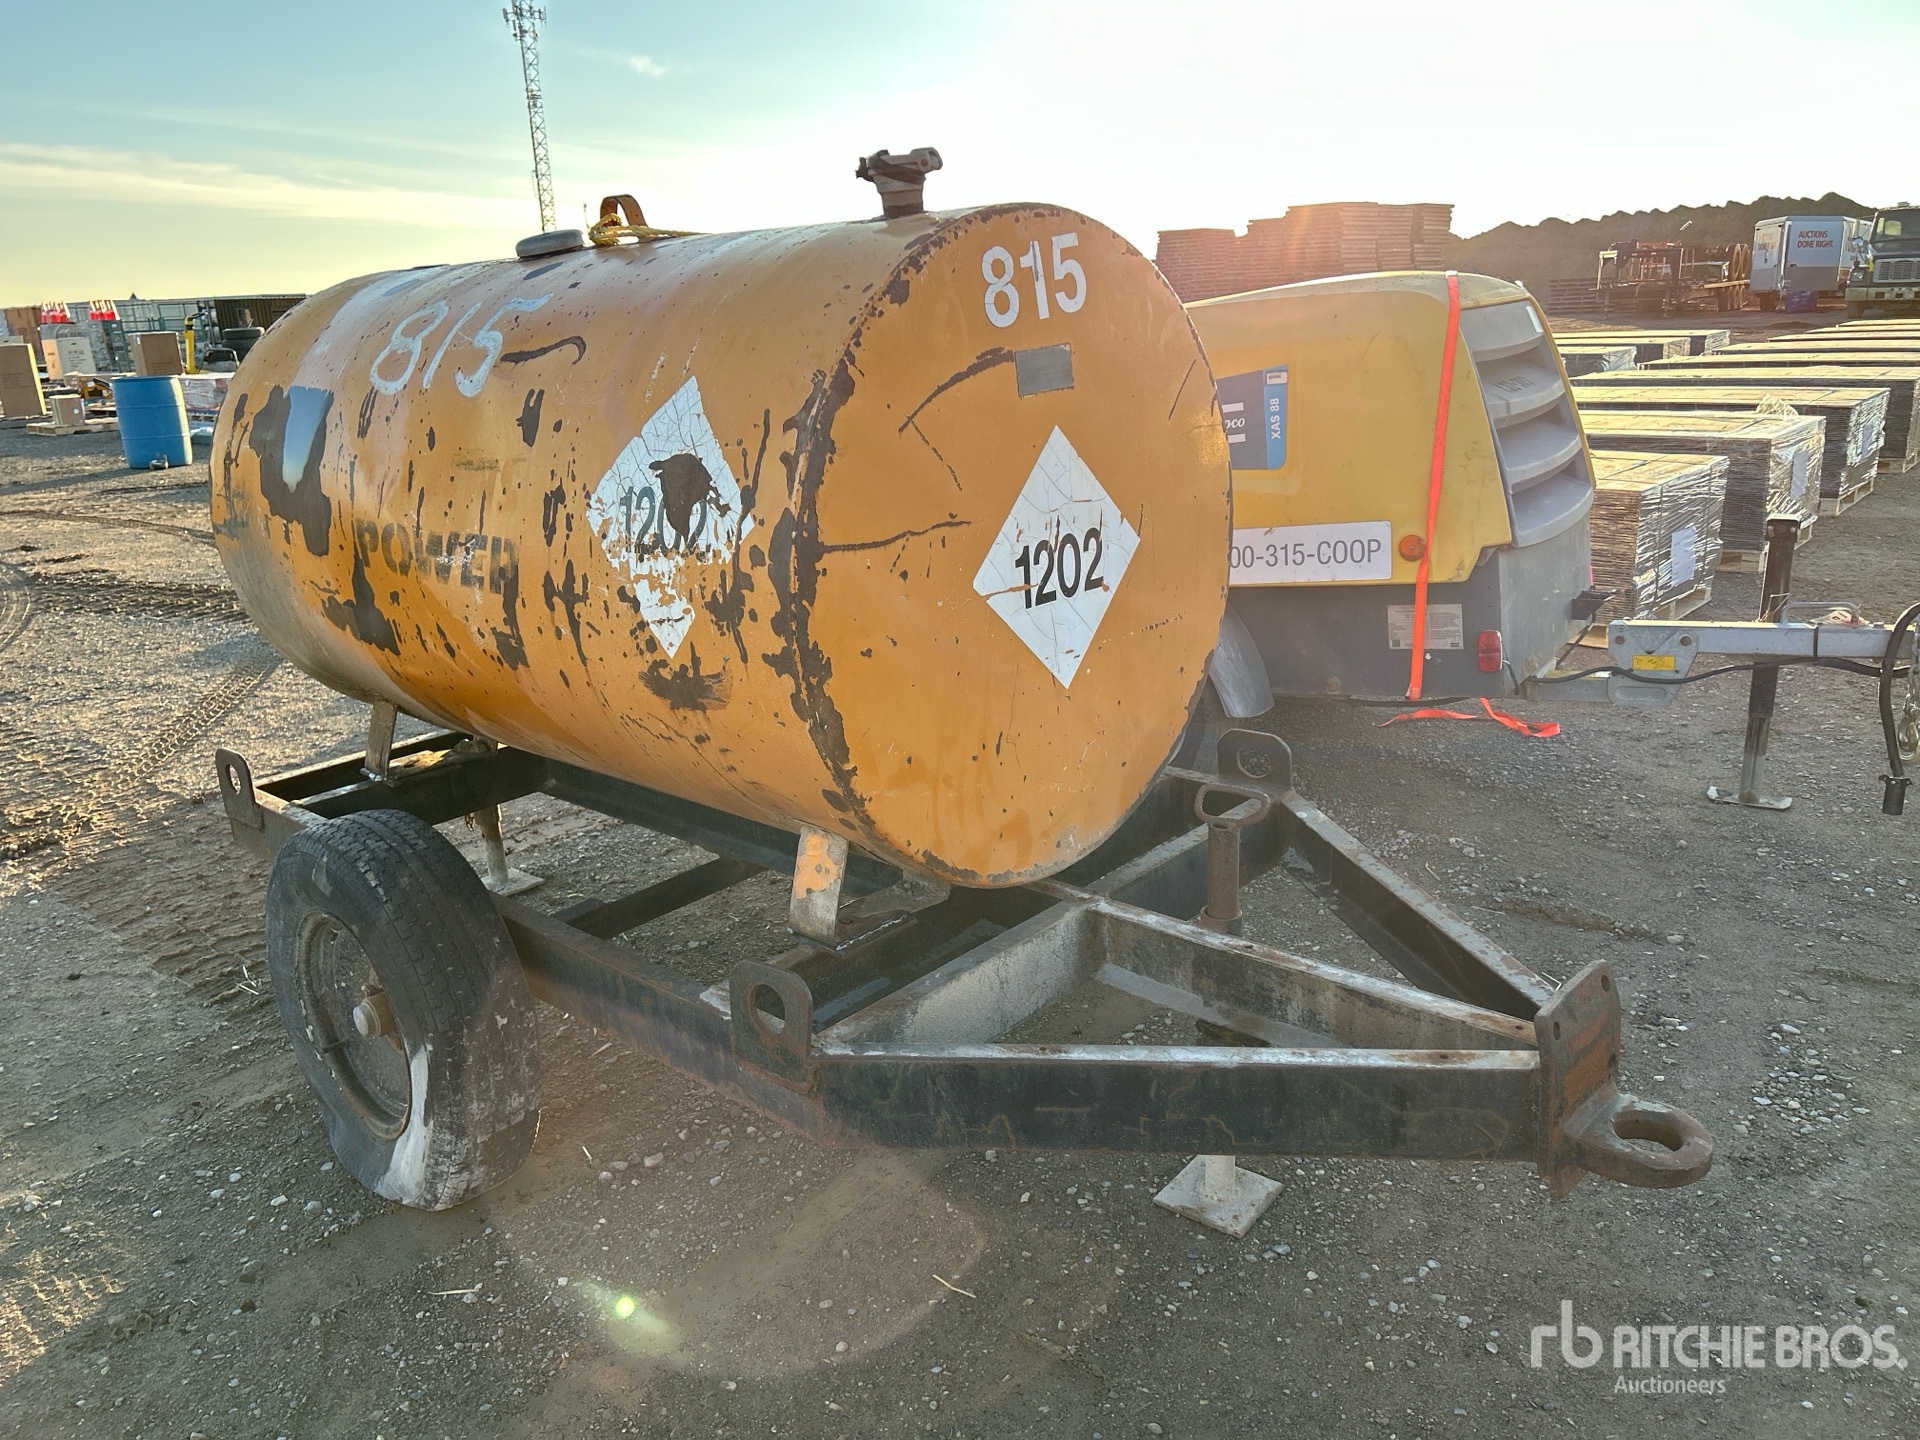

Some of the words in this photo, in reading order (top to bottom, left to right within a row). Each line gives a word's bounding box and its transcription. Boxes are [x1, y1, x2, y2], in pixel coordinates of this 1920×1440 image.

[1797, 240, 1815, 248] DONE
[1798, 230, 1829, 239] AUCTIONS
[981, 231, 1087, 328] 815
[370, 292, 556, 397] 815
[1269, 397, 1280, 412] 88
[1269, 415, 1281, 440] XAS
[1015, 527, 1104, 609] 1202
